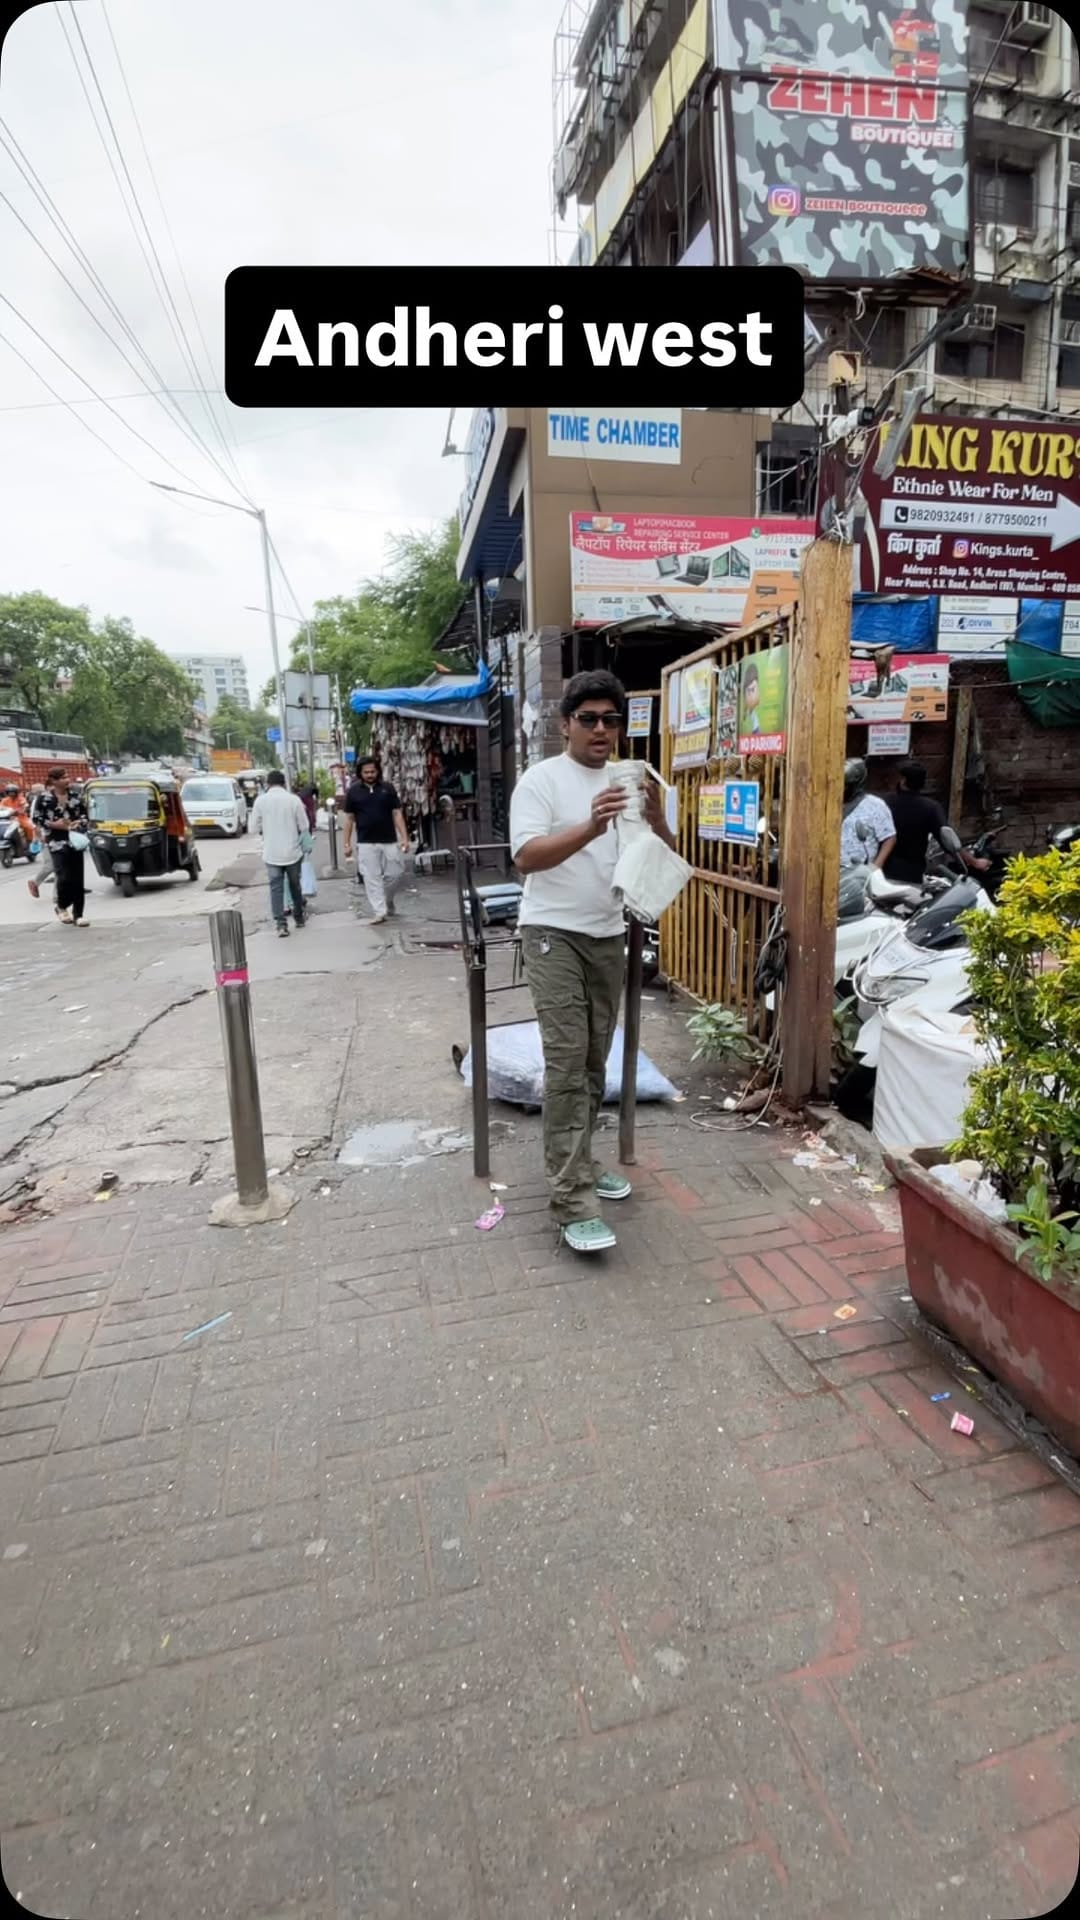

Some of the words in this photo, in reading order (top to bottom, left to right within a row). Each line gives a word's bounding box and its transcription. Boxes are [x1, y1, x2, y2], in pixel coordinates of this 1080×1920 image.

[766, 65, 940, 124] ZEHEN
[549, 413, 590, 442] TIME
[596, 417, 680, 448] CHAMBER
[987, 429, 1080, 479] KUR
[947, 480, 989, 499] Wear
[992, 482, 1019, 500] For
[1020, 484, 1054, 502] Men
[910, 508, 975, 524] 9820932491
[984, 512, 1048, 528] 8779500211
